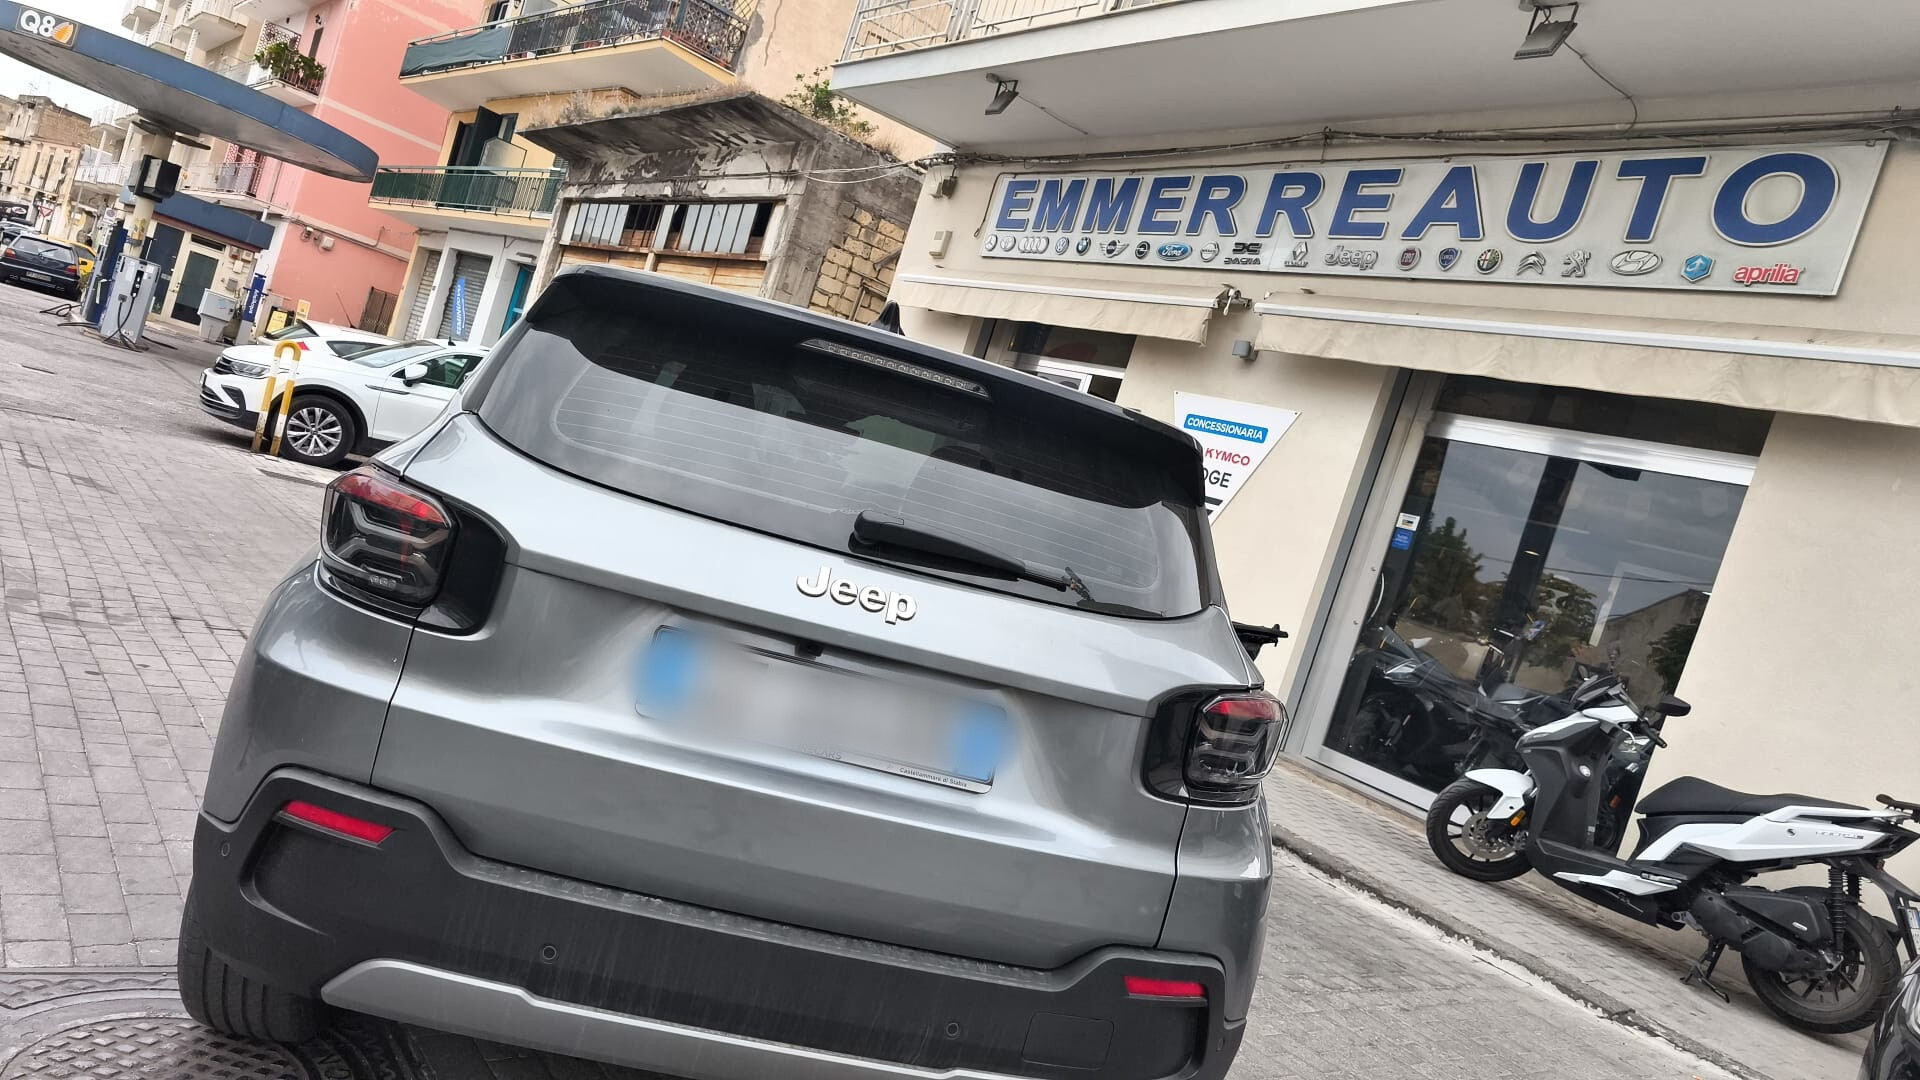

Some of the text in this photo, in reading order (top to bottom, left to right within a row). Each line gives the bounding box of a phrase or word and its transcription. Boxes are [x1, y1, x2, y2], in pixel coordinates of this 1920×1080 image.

[20, 10, 56, 38] Q8
[1161, 244, 1186, 257] Ford
[1324, 245, 1378, 270] Jeep
[1733, 263, 1801, 286] aprilia
[1187, 417, 1264, 441] CONCESSIONARIA
[1205, 448, 1251, 466] KYMCO
[795, 565, 919, 625] Jeep
